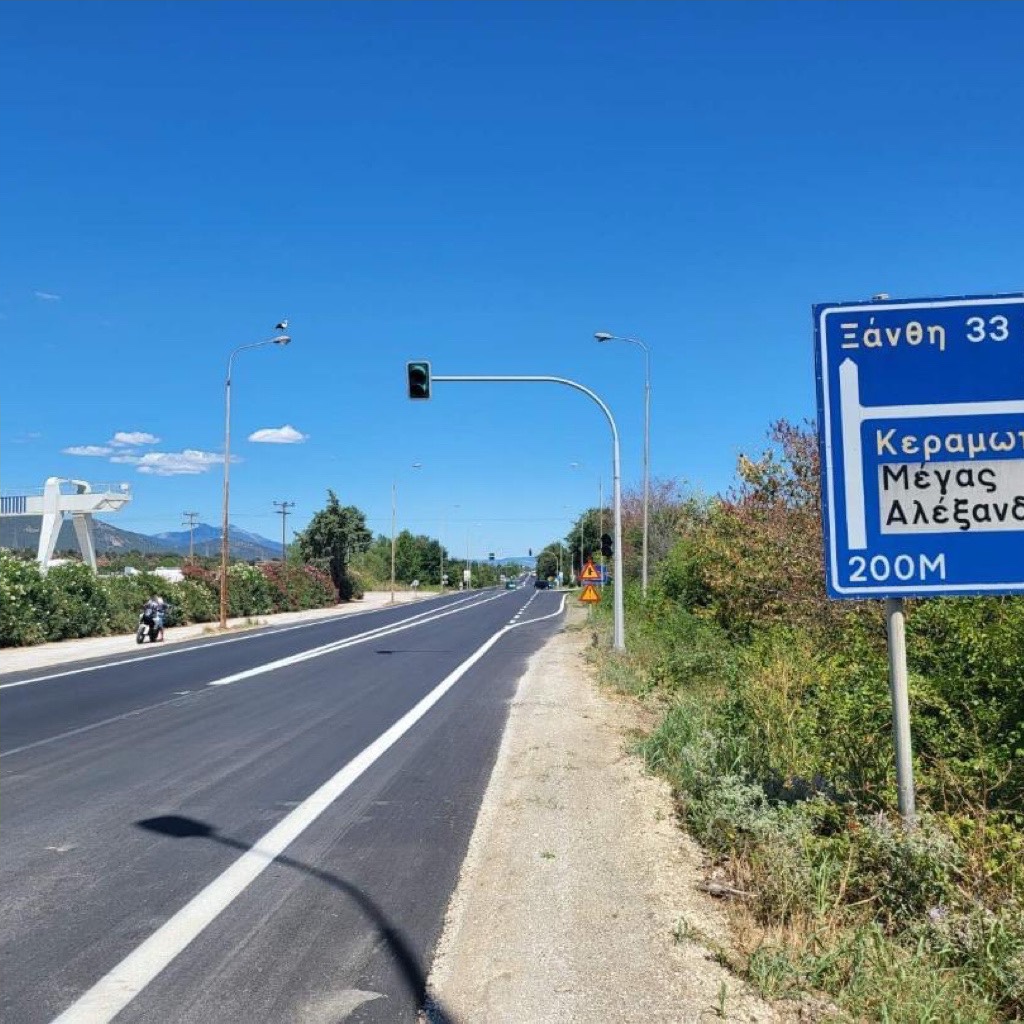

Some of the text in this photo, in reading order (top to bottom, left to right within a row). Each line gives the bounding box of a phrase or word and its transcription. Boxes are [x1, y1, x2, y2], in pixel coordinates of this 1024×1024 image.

[840, 316, 1009, 352] Ξάνθη 33
[883, 462, 997, 495] Μέγας
[886, 496, 1024, 531] Αλέξανδ
[849, 554, 946, 583] 200M
